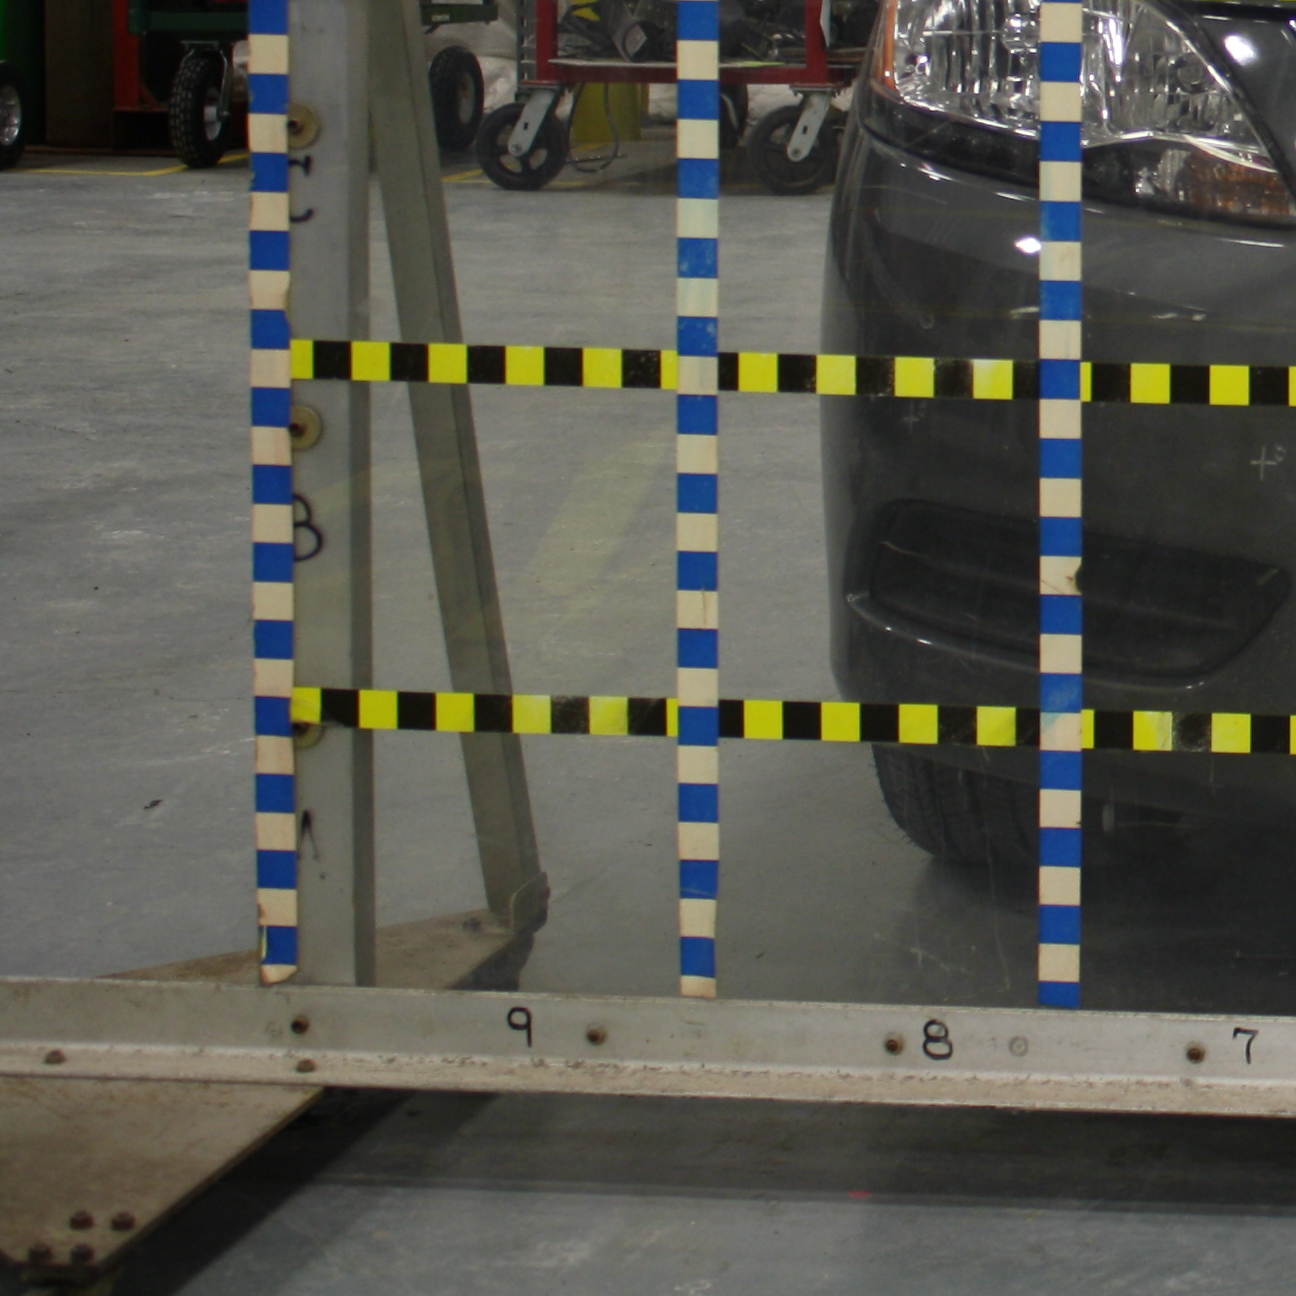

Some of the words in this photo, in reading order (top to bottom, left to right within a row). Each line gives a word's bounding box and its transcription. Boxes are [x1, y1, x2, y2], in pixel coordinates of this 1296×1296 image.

[507, 1007, 532, 1047] 9
[922, 1019, 953, 1060] 8
[1232, 1027, 1258, 1064] 7
